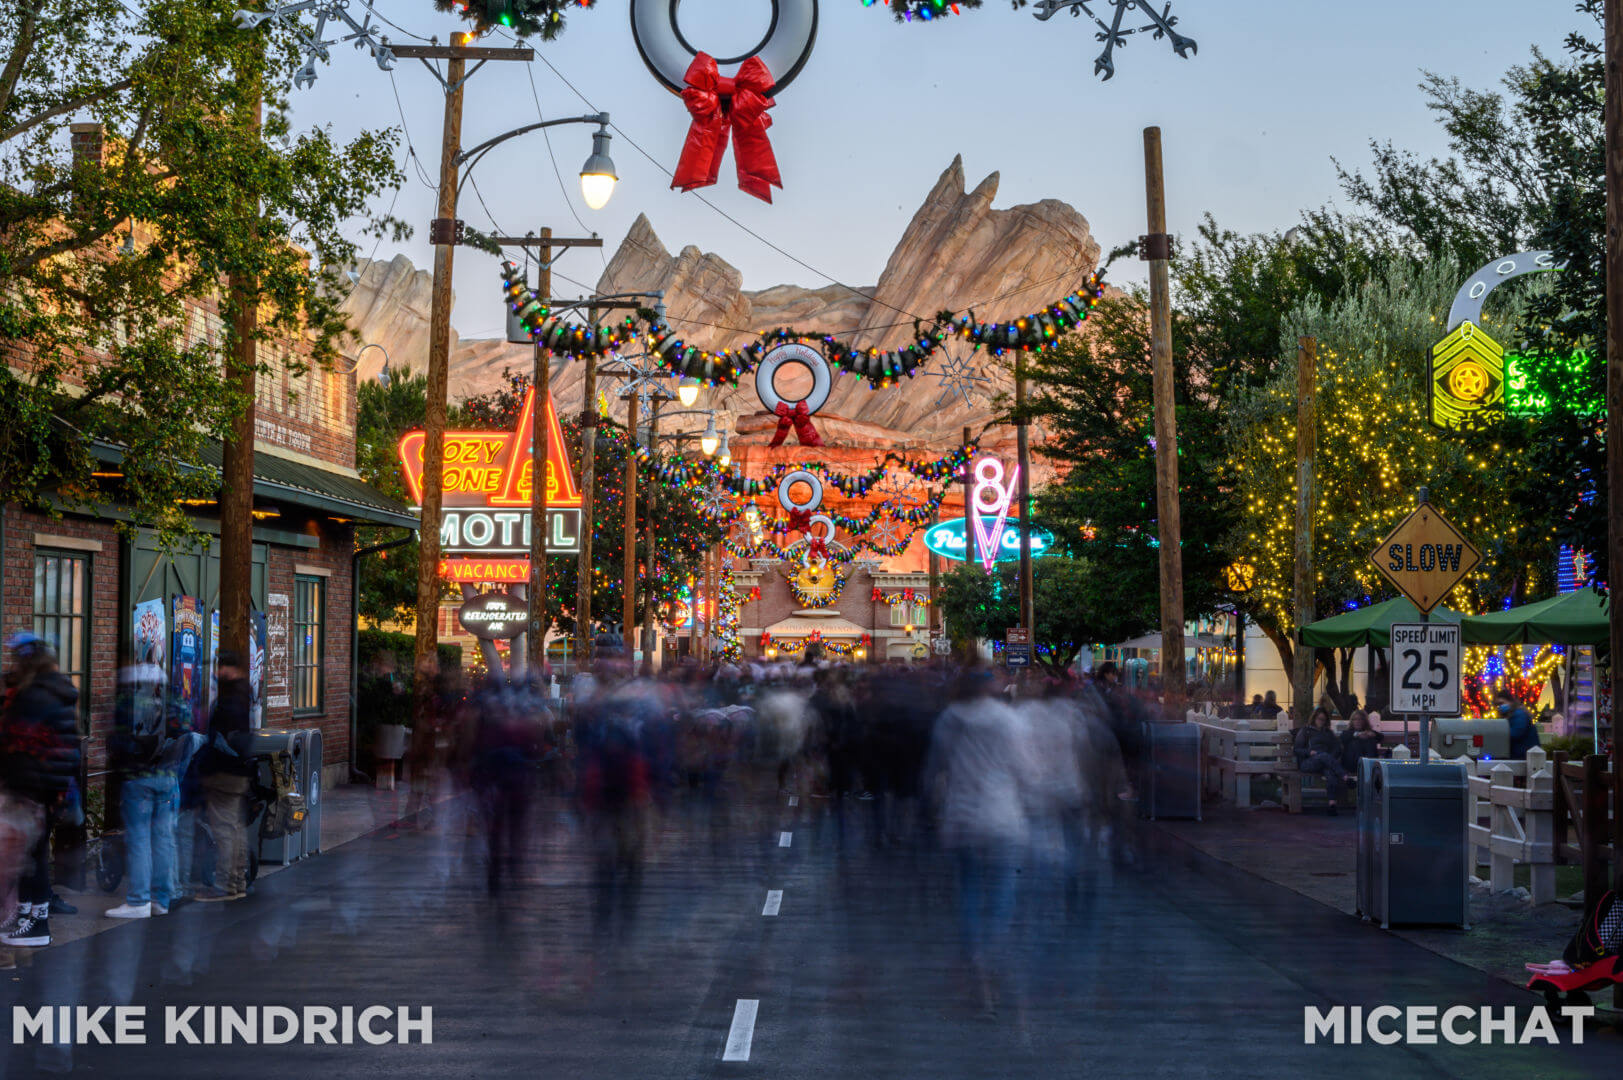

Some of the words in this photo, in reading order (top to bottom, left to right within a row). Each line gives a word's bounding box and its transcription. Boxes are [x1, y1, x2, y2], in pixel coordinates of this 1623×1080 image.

[972, 457, 1006, 513] 8
[1388, 543, 1463, 572] SLOW
[453, 563, 529, 579] VACANCY
[463, 611, 528, 621] REFRIGERATED
[487, 622, 505, 631] AIR
[1395, 629, 1427, 644] SPEED
[1429, 629, 1457, 644] LIMIT
[1401, 648, 1449, 690] 25
[1411, 694, 1436, 707] MPH
